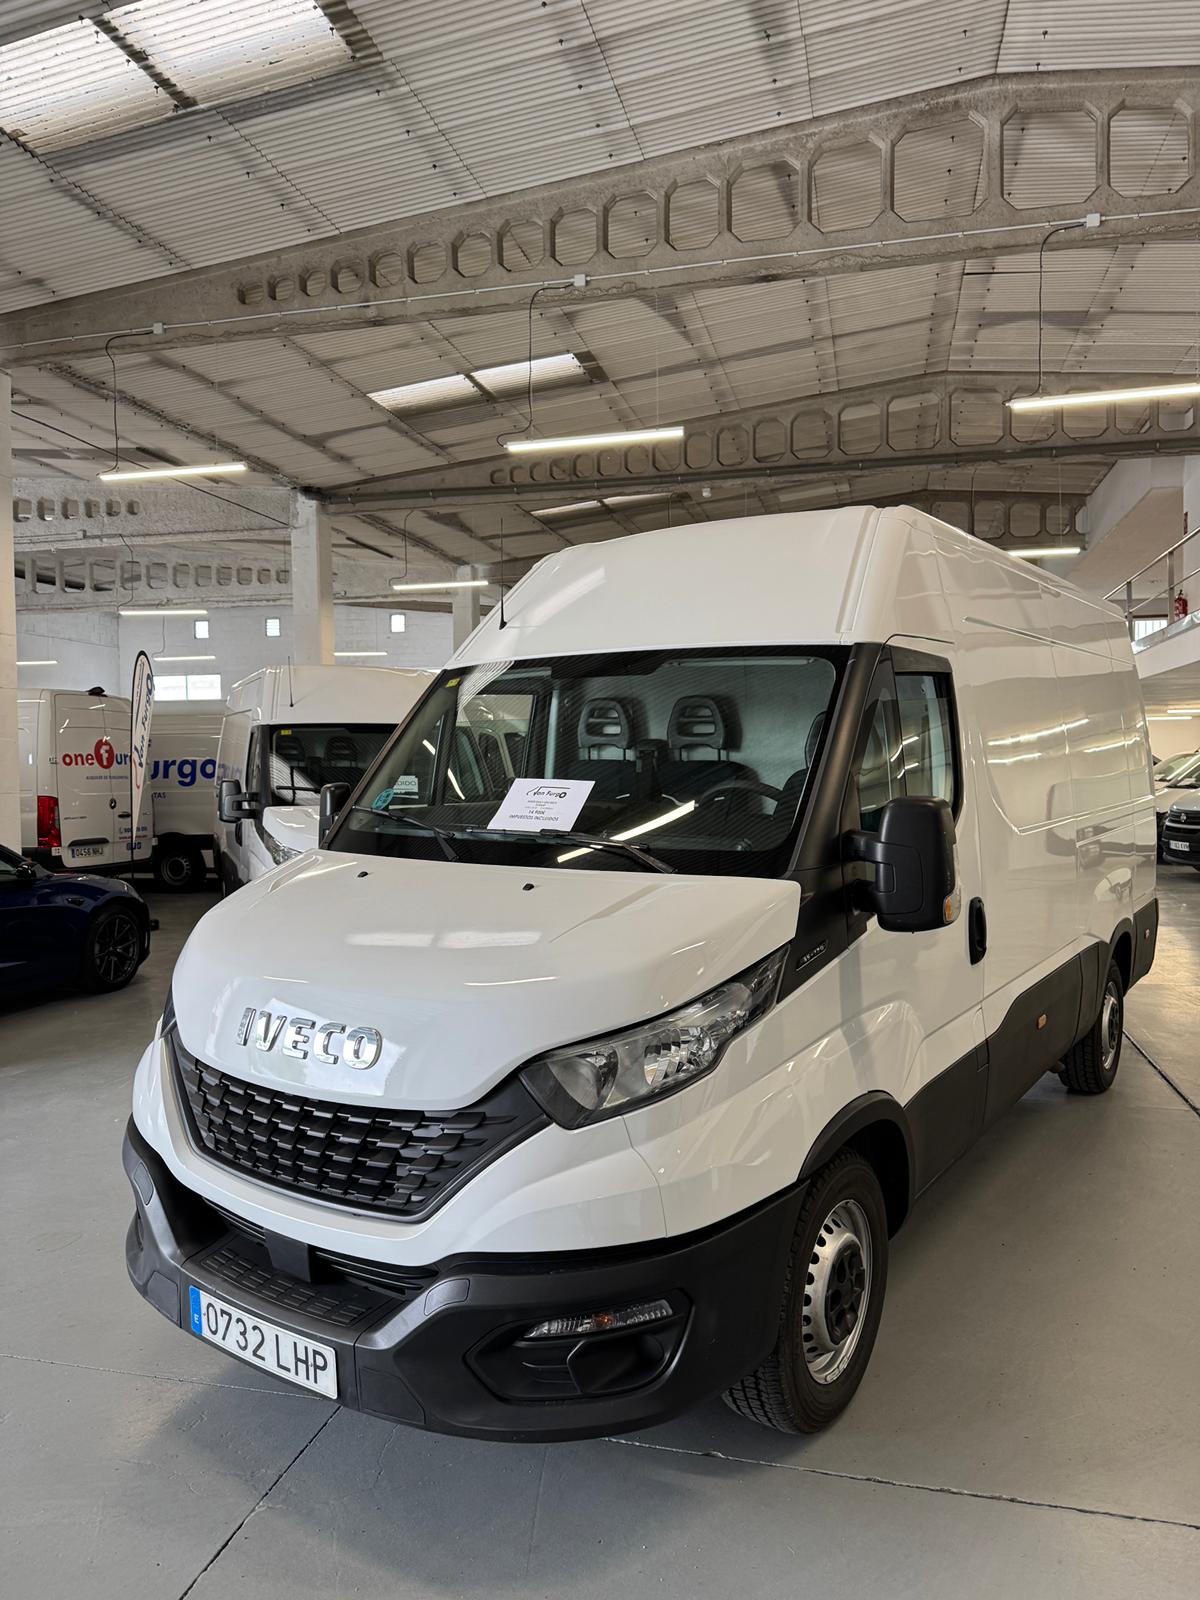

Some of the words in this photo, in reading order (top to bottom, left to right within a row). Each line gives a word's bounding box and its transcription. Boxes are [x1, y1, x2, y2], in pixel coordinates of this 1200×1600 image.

[237, 1007, 384, 1071] IVECO
[206, 1303, 266, 1363] 0732
[274, 1333, 329, 1386] LHP
